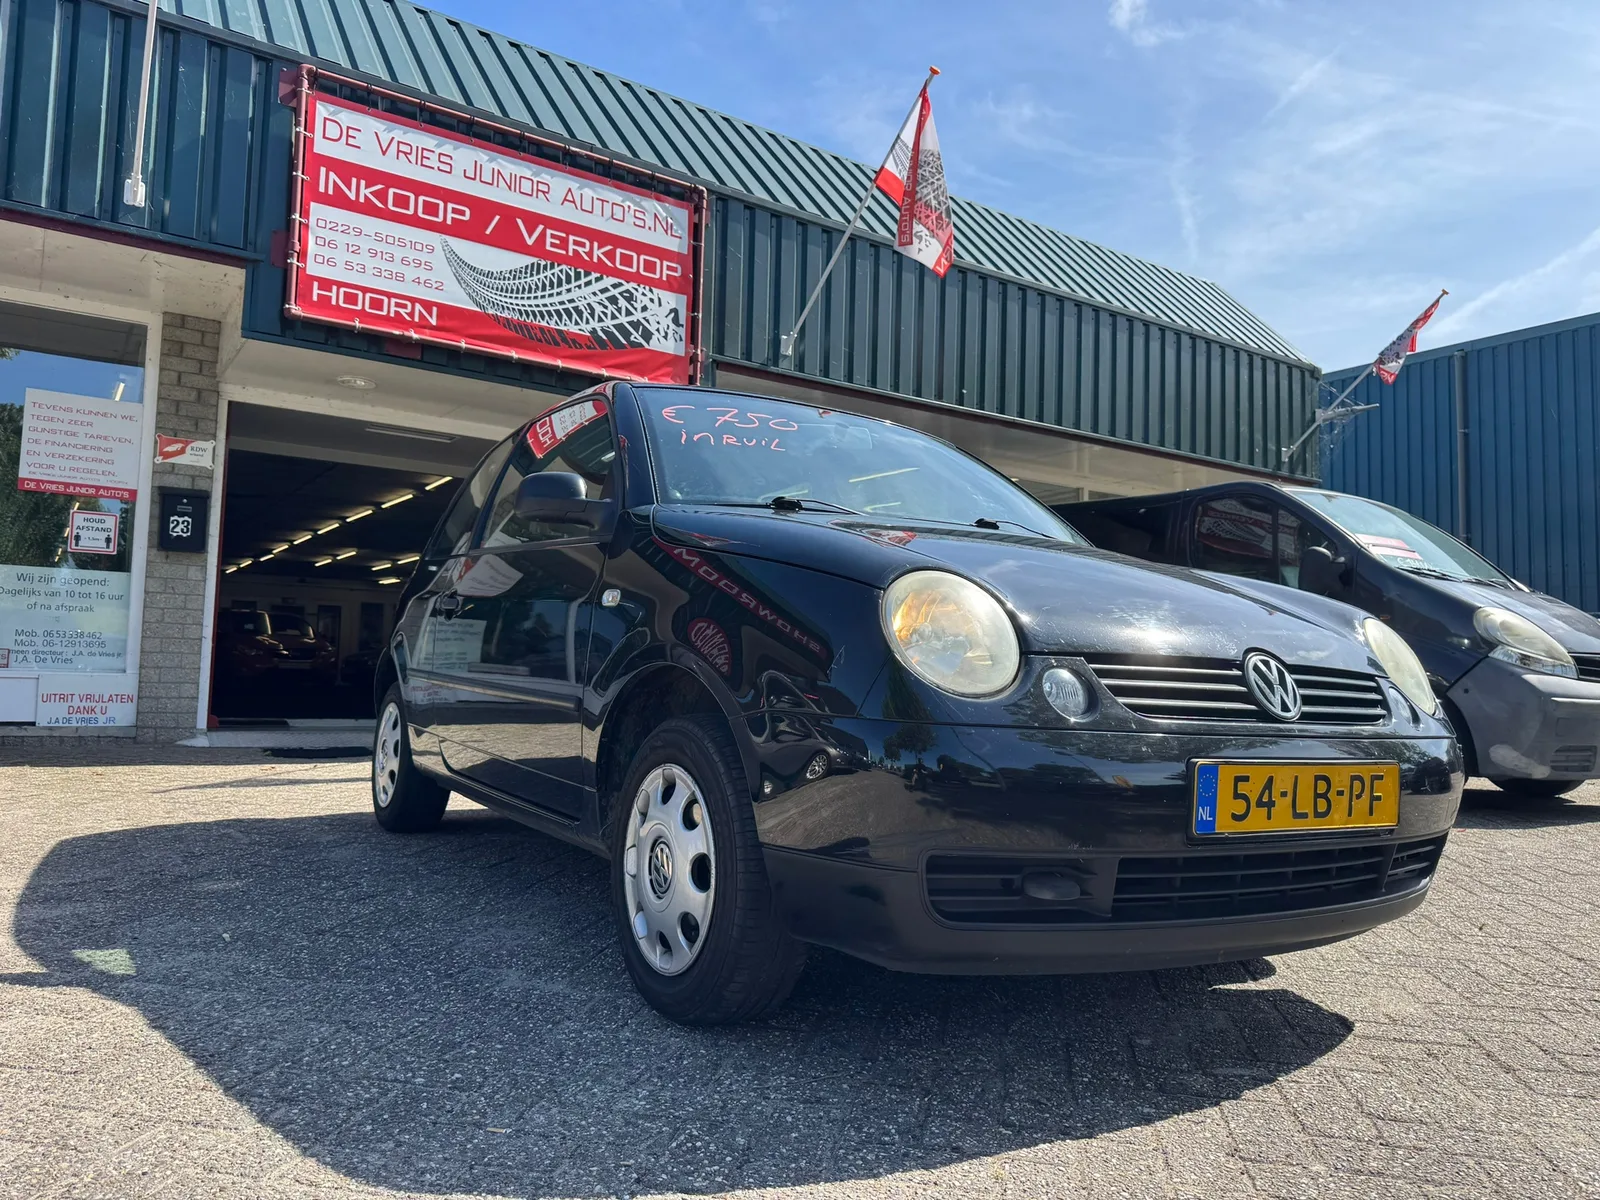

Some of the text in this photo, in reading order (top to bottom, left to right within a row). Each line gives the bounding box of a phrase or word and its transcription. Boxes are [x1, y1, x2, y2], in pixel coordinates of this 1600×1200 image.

[322, 116, 682, 239] DE VRIES JUNIOR AUTO'S.NL
[318, 166, 471, 225] INKOOP
[515, 217, 682, 281] VERKOOP
[316, 217, 435, 254] 0229-505109
[314, 235, 433, 271] 06 12 913 695
[313, 253, 444, 291] 06 53 338 462
[312, 281, 437, 326] HOORN
[31, 401, 73, 413] TEVENS
[76, 408, 117, 419] KUNNEN
[30, 414, 94, 428] TEGEN ZEER
[706, 407, 798, 431] 750
[28, 426, 80, 438] GUNSTIGE
[44, 440, 113, 453] FINANCIERING
[26, 461, 56, 470] VOOR
[43, 451, 115, 466] VERZEKERING
[24, 480, 130, 498] DE VRIES JUNIOR AUTO'S
[75, 525, 112, 533] AFSTAND
[170, 518, 191, 535] 23
[16, 572, 110, 587] Wij zijn geopend:
[0, 586, 42, 598] Dagelijks
[65, 590, 76, 598] 10
[78, 591, 92, 599] tot
[95, 591, 106, 600] 16
[26, 601, 95, 613] of na afspraak
[14, 628, 40, 638] Mob.
[14, 638, 107, 649] Mob. 06-12913695
[34, 655, 50, 663] De
[50, 655, 74, 664] Vries
[41, 693, 134, 704] UITRIT VRIJLATEN
[67, 705, 108, 715] DANK U
[61, 717, 73, 725] DE
[75, 717, 99, 725] VRIES
[102, 716, 116, 725] JR
[1230, 773, 1385, 823] 54-LB-PF
[1197, 806, 1213, 821] NL
